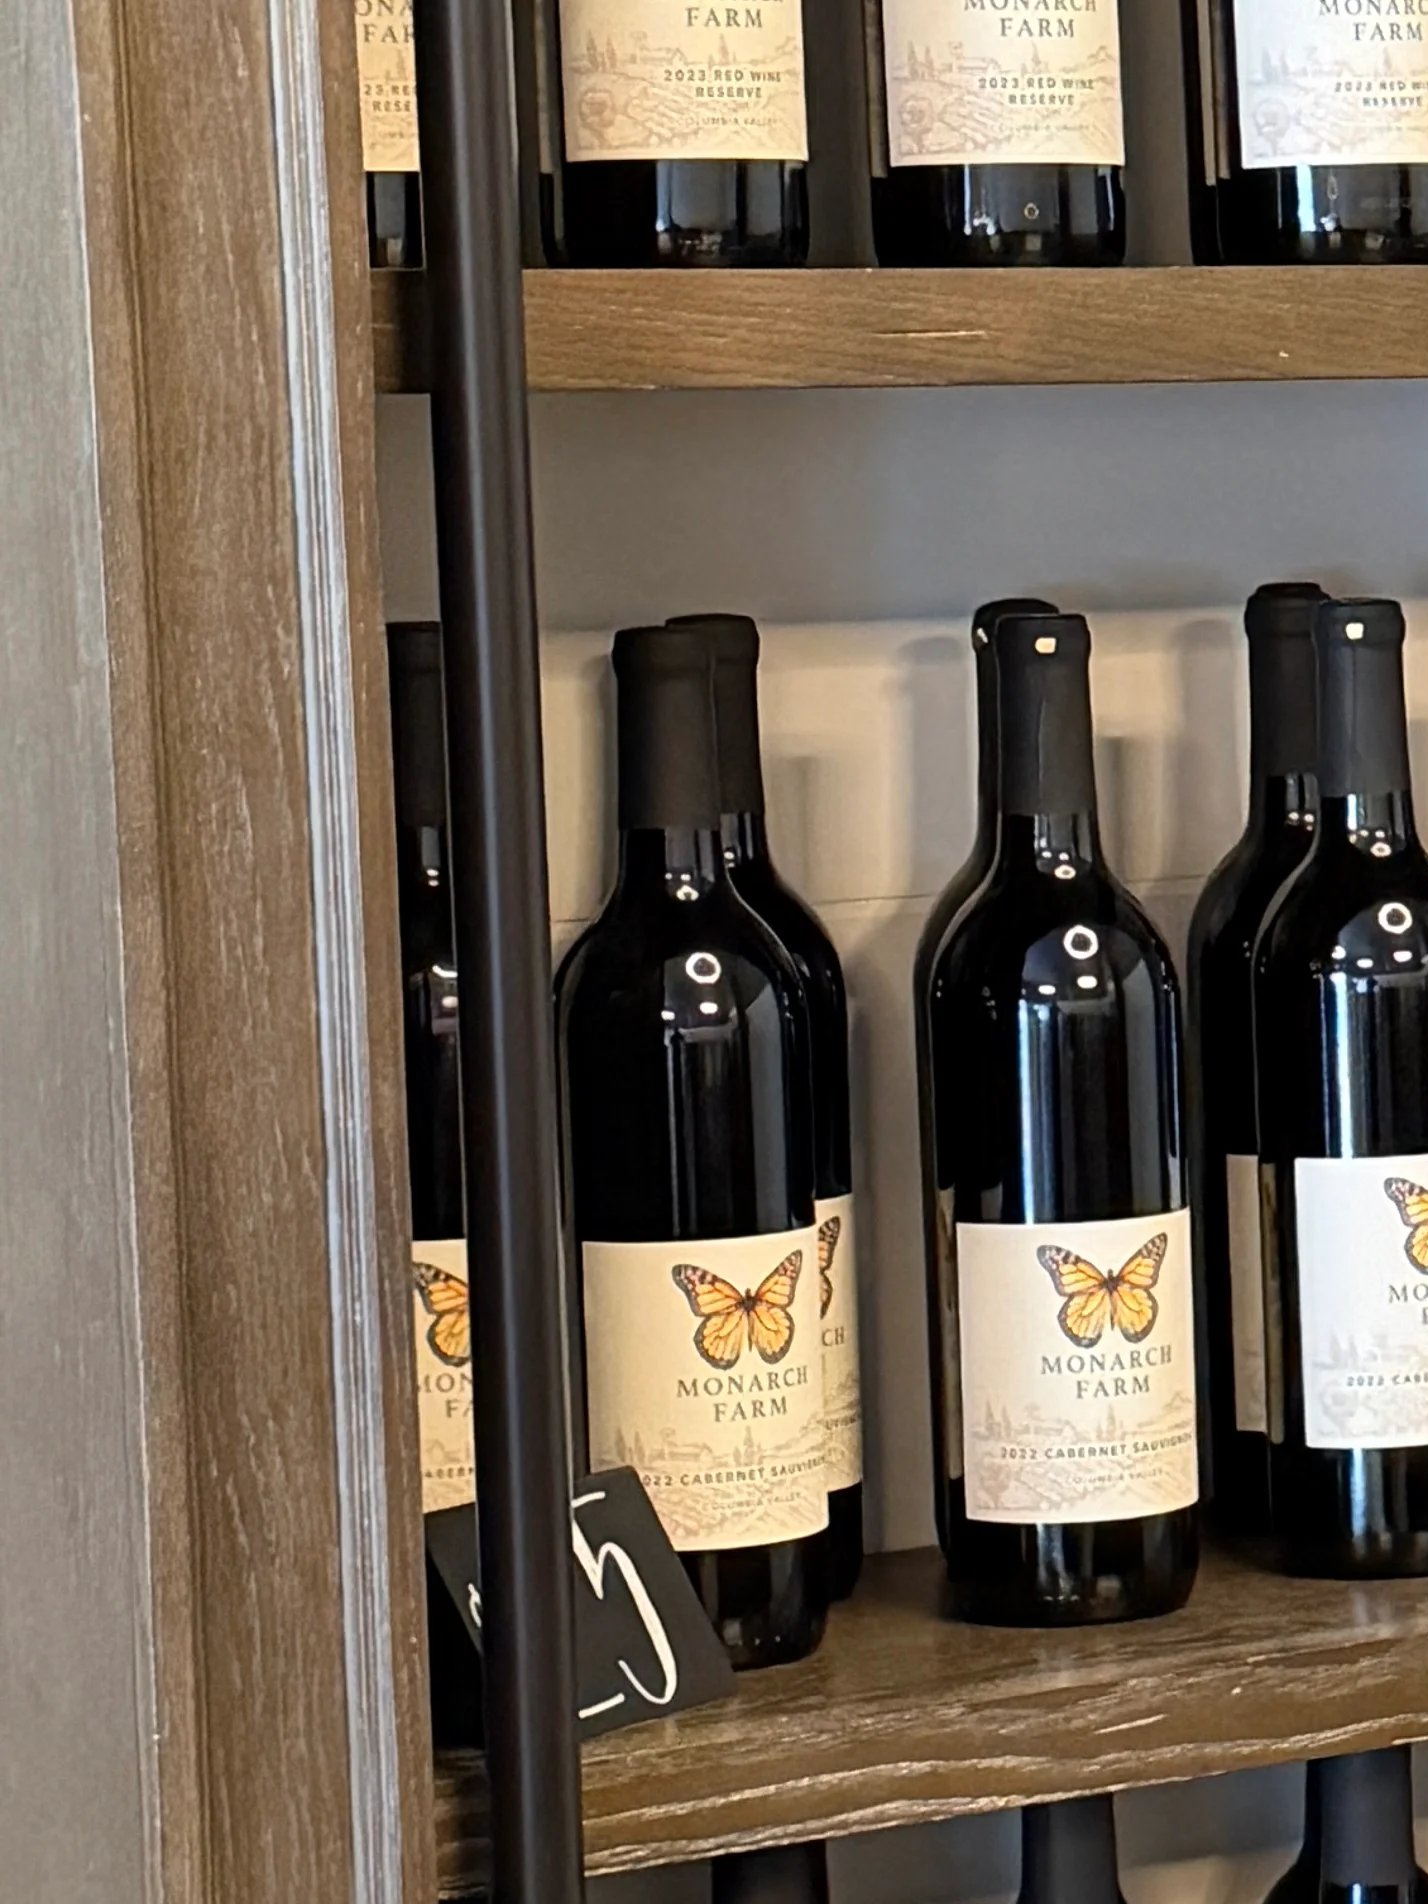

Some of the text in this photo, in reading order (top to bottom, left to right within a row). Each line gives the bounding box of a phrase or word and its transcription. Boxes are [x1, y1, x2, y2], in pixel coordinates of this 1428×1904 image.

[686, 6, 763, 28] FARM
[999, 18, 1074, 39] FARM
[1352, 22, 1424, 43] FARM
[664, 70, 782, 83] 2023 RED WINE
[978, 76, 1020, 90] 2023
[1026, 76, 1056, 90] RED
[695, 86, 762, 99] RESERVE
[1008, 93, 1075, 106] RESERVE
[1040, 1344, 1172, 1376] MONARCH
[676, 1364, 809, 1398] MONARCH
[1076, 1374, 1151, 1400] FARM
[713, 1395, 788, 1424] FARM
[1001, 1447, 1038, 1460] 2022
[1044, 1443, 1127, 1459] CABERNET
[641, 1473, 673, 1488] 022
[679, 1467, 765, 1487] CABERNET
